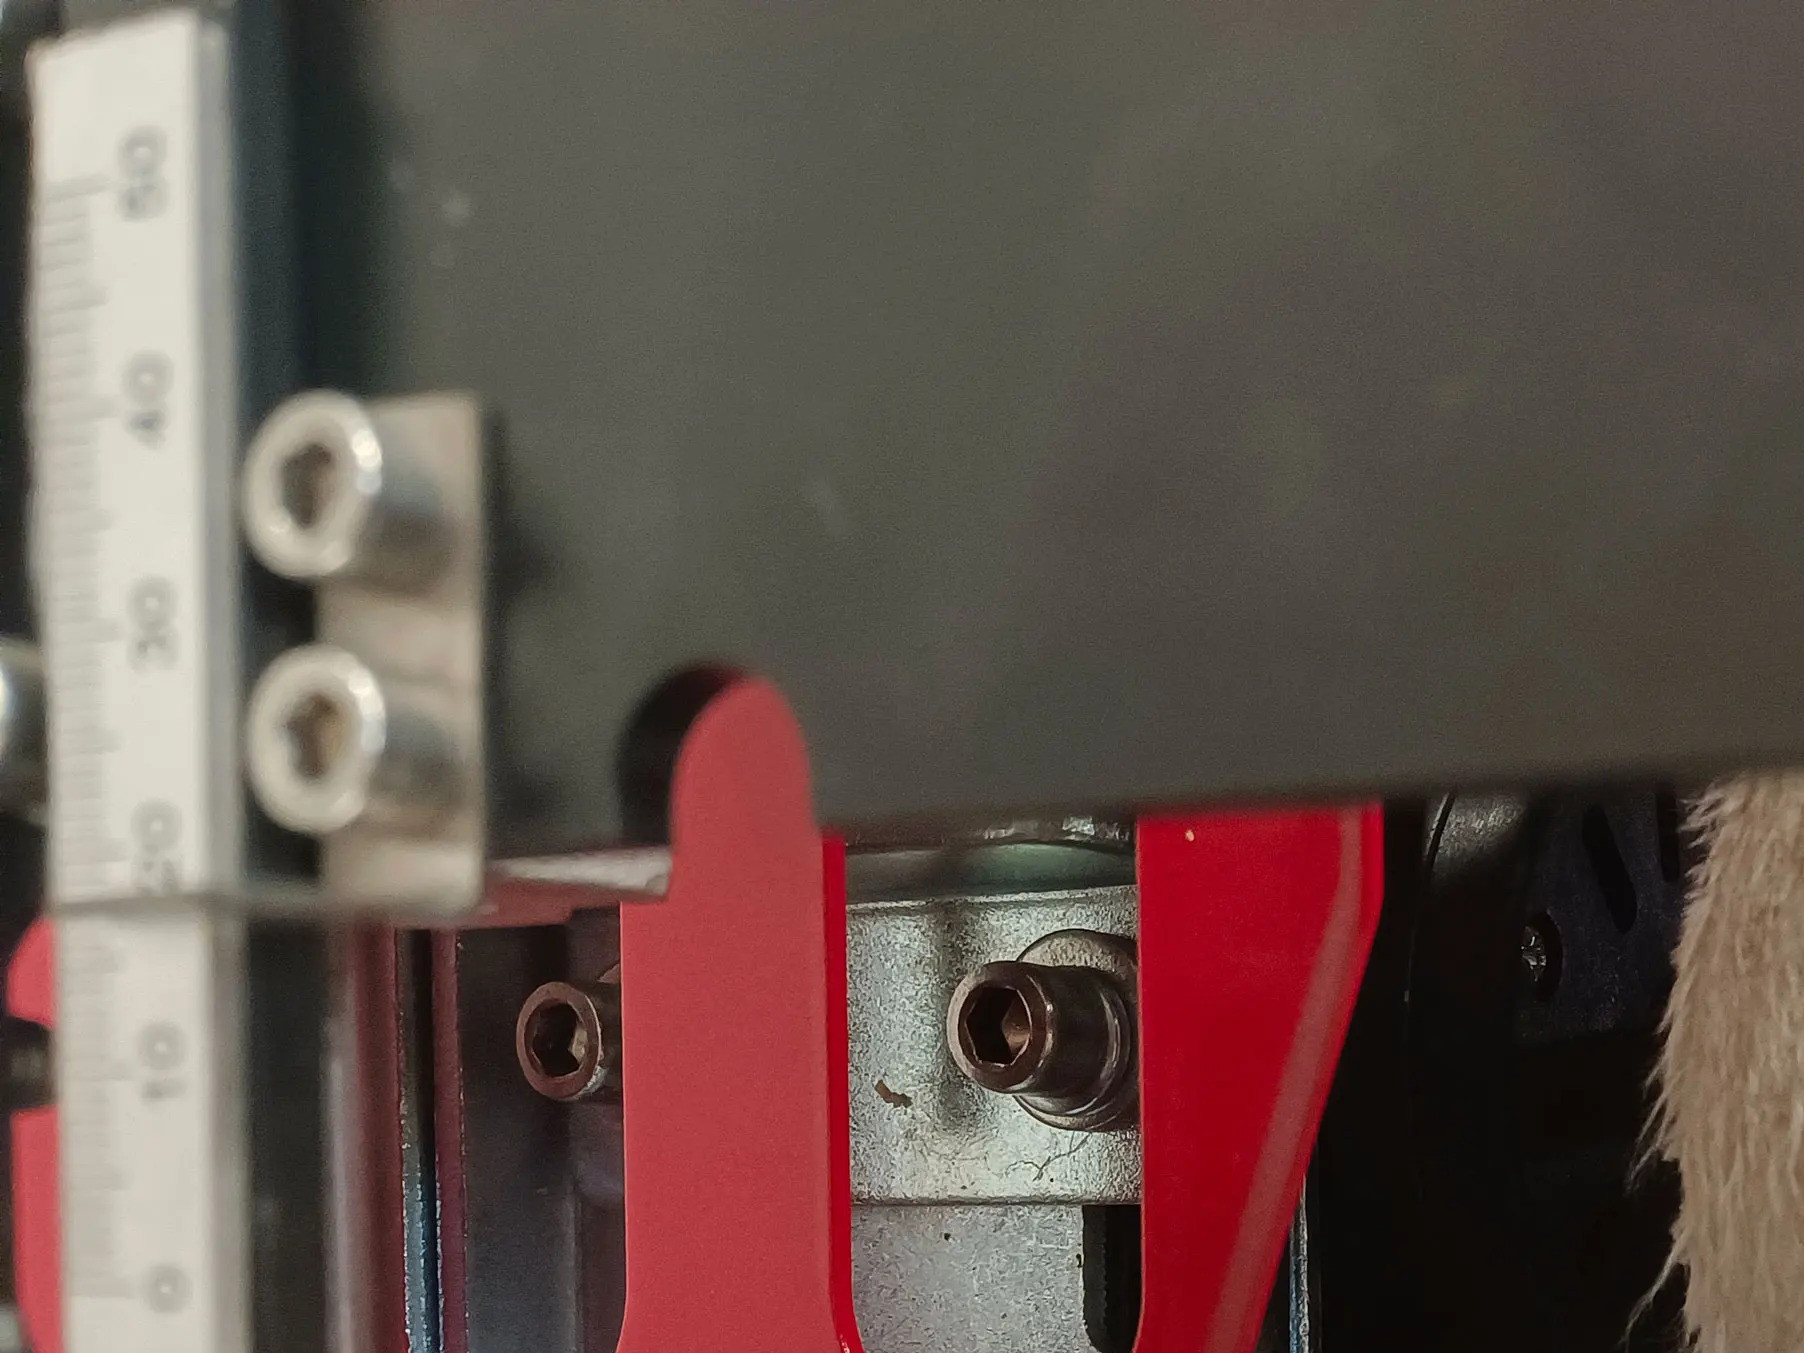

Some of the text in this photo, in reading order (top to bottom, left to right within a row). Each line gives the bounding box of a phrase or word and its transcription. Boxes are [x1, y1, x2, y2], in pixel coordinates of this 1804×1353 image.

[124, 352, 174, 451] 40
[128, 578, 180, 672] 30
[138, 1022, 187, 1103] 10
[144, 1264, 193, 1316] 0
